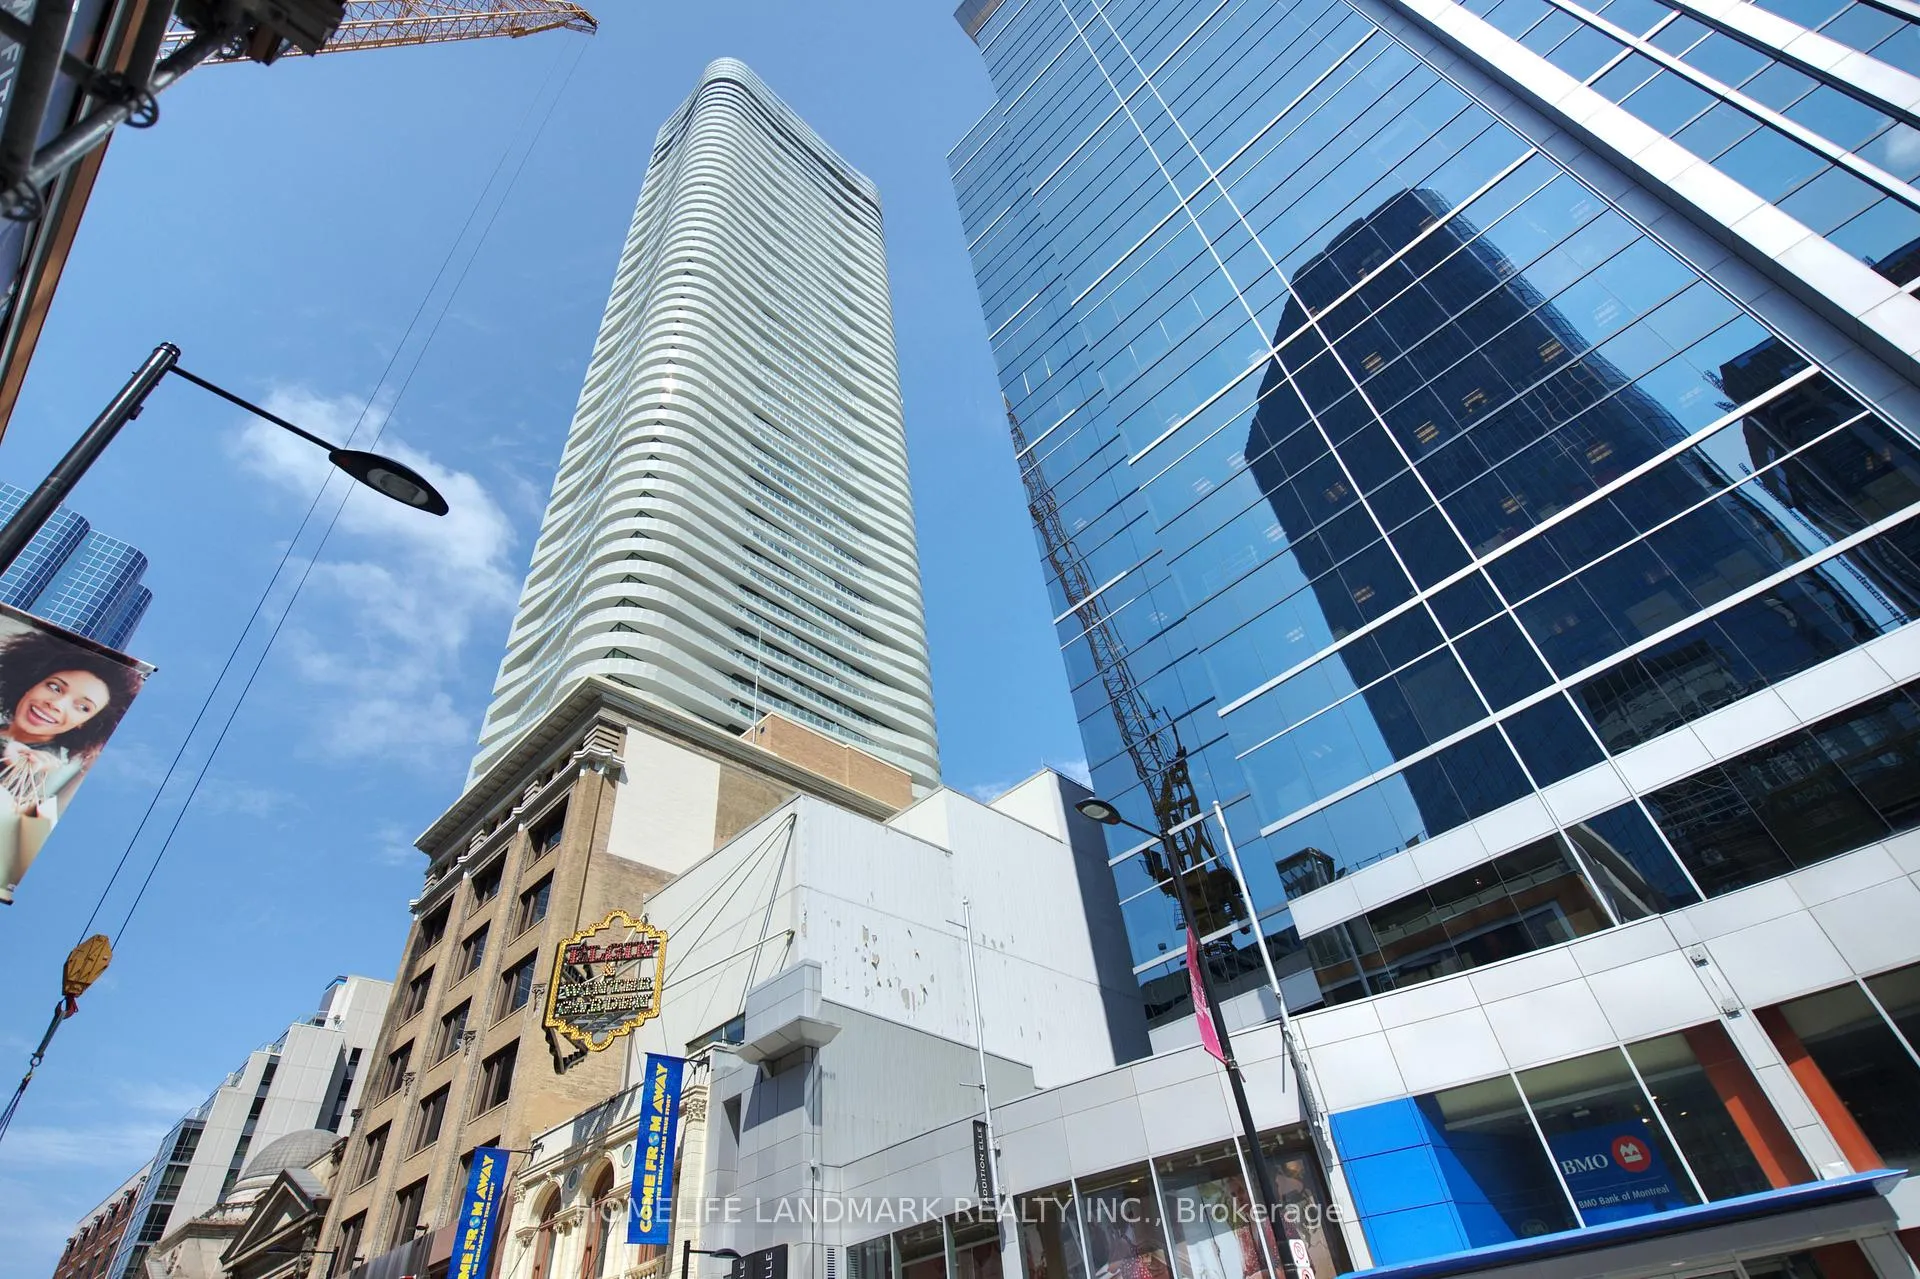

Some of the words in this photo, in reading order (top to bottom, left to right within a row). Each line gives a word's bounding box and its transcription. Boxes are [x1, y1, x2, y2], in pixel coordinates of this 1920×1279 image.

[567, 941, 657, 966] ELGIN
[562, 977, 652, 998] WINTER
[558, 994, 651, 1016] GARDEN
[640, 1173, 656, 1233] COME
[652, 1062, 668, 1114] AWAY
[476, 1154, 495, 1200] AWAY
[1561, 1154, 1609, 1176] BMO
[979, 1153, 989, 1204] ADDITION
[1578, 1199, 1597, 1209] BMO
[1599, 1193, 1620, 1205] Bank
[1622, 1192, 1631, 1201] of
[1632, 1184, 1670, 1198] Montreal
